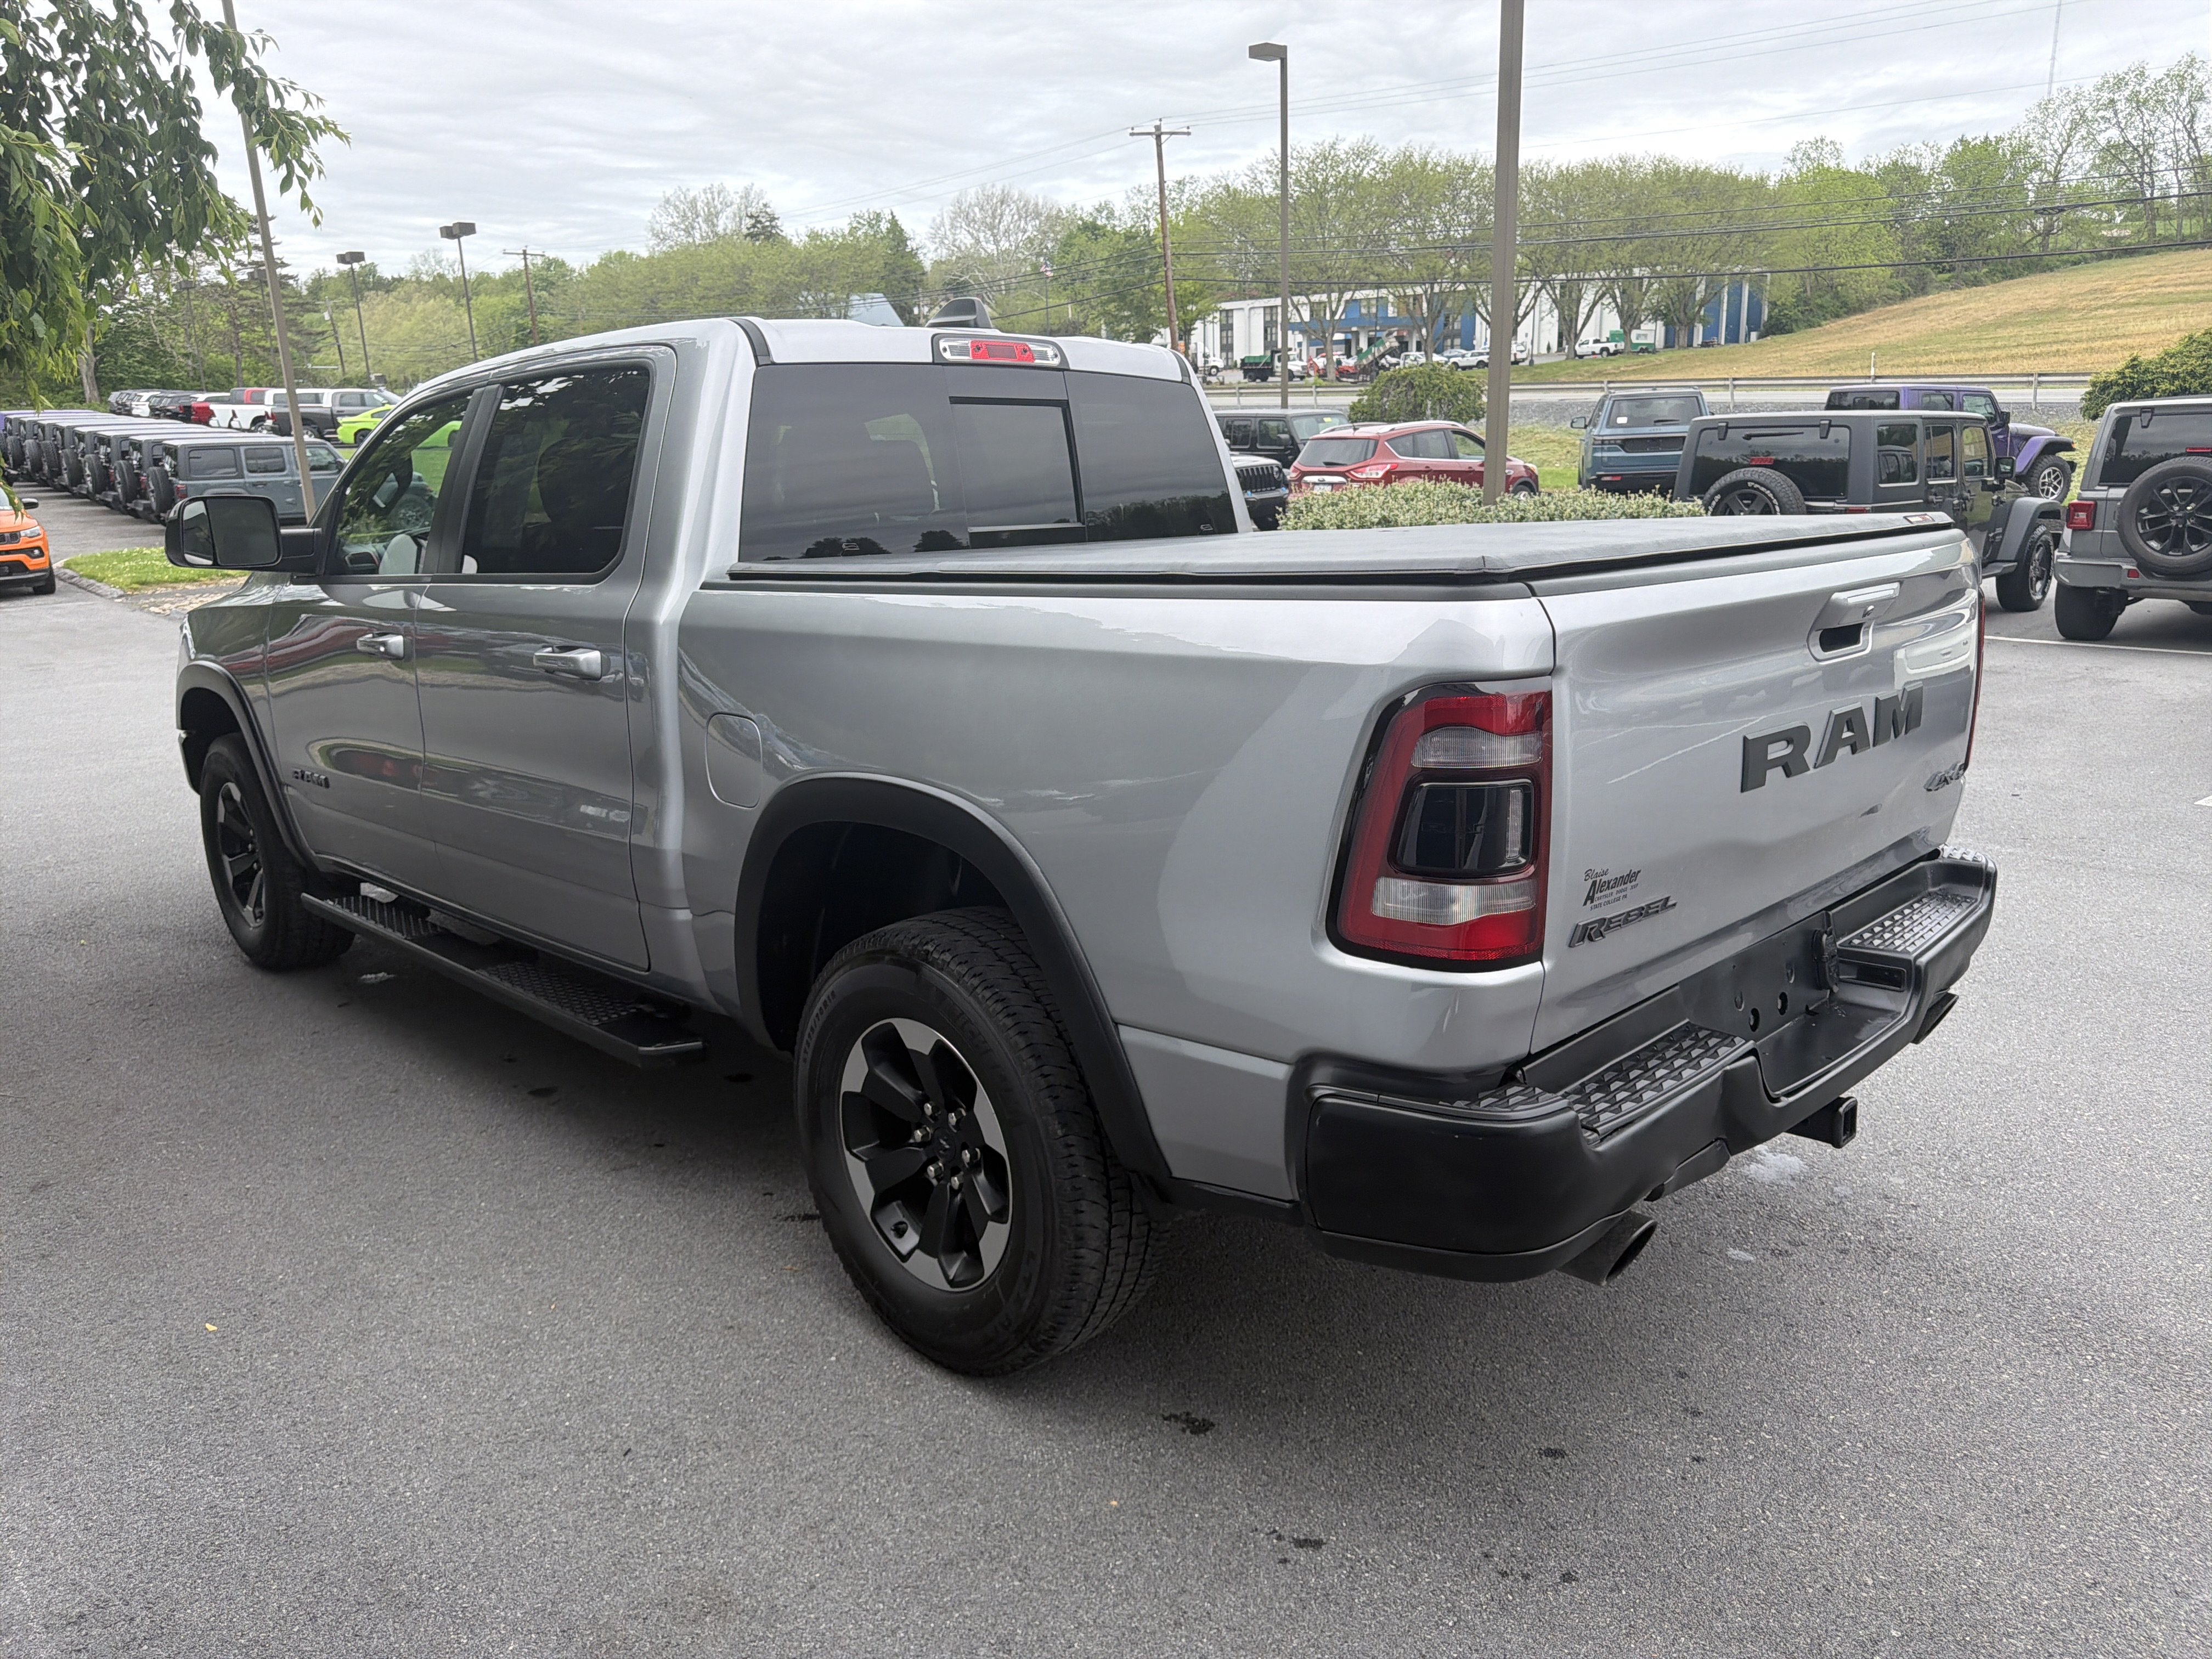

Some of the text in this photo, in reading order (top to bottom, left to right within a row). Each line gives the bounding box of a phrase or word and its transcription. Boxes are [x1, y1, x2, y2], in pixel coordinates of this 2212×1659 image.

[1741, 681, 1923, 793] RAM
[1582, 869, 1641, 907] Alexander
[1584, 868, 1609, 882] Blaise
[1568, 895, 1678, 948] REBEL
[1590, 902, 1602, 911] STATE
[1603, 896, 1621, 907] COLLEGE
